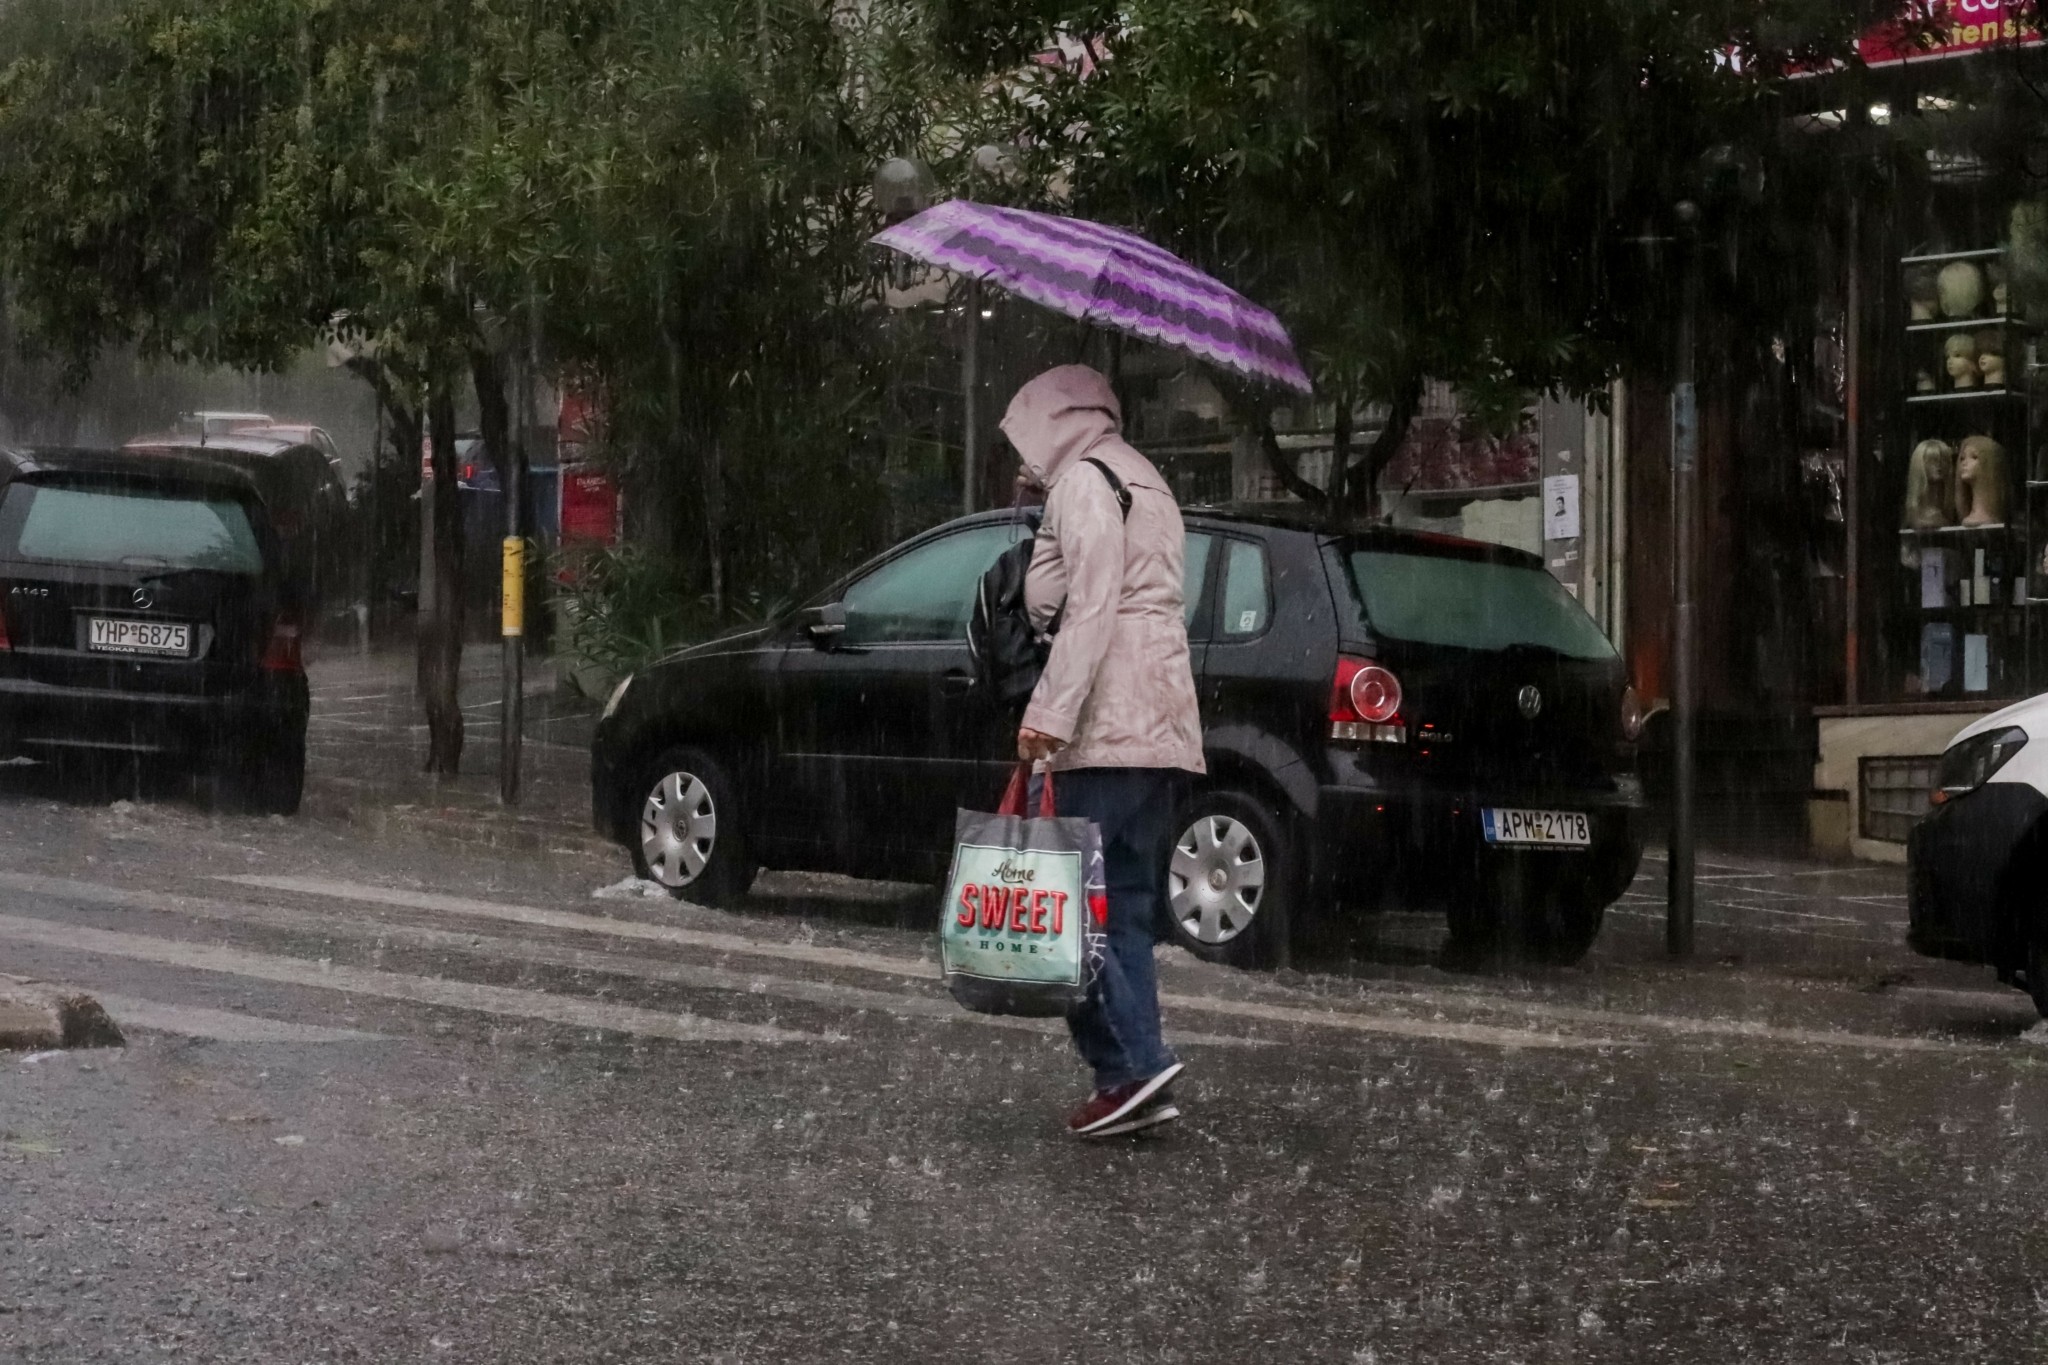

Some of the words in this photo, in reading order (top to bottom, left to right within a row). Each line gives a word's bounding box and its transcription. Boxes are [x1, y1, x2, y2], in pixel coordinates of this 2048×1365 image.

[991, 859, 1035, 885] Home
[957, 883, 1069, 935] SWEET
[979, 940, 1038, 954] HOME
